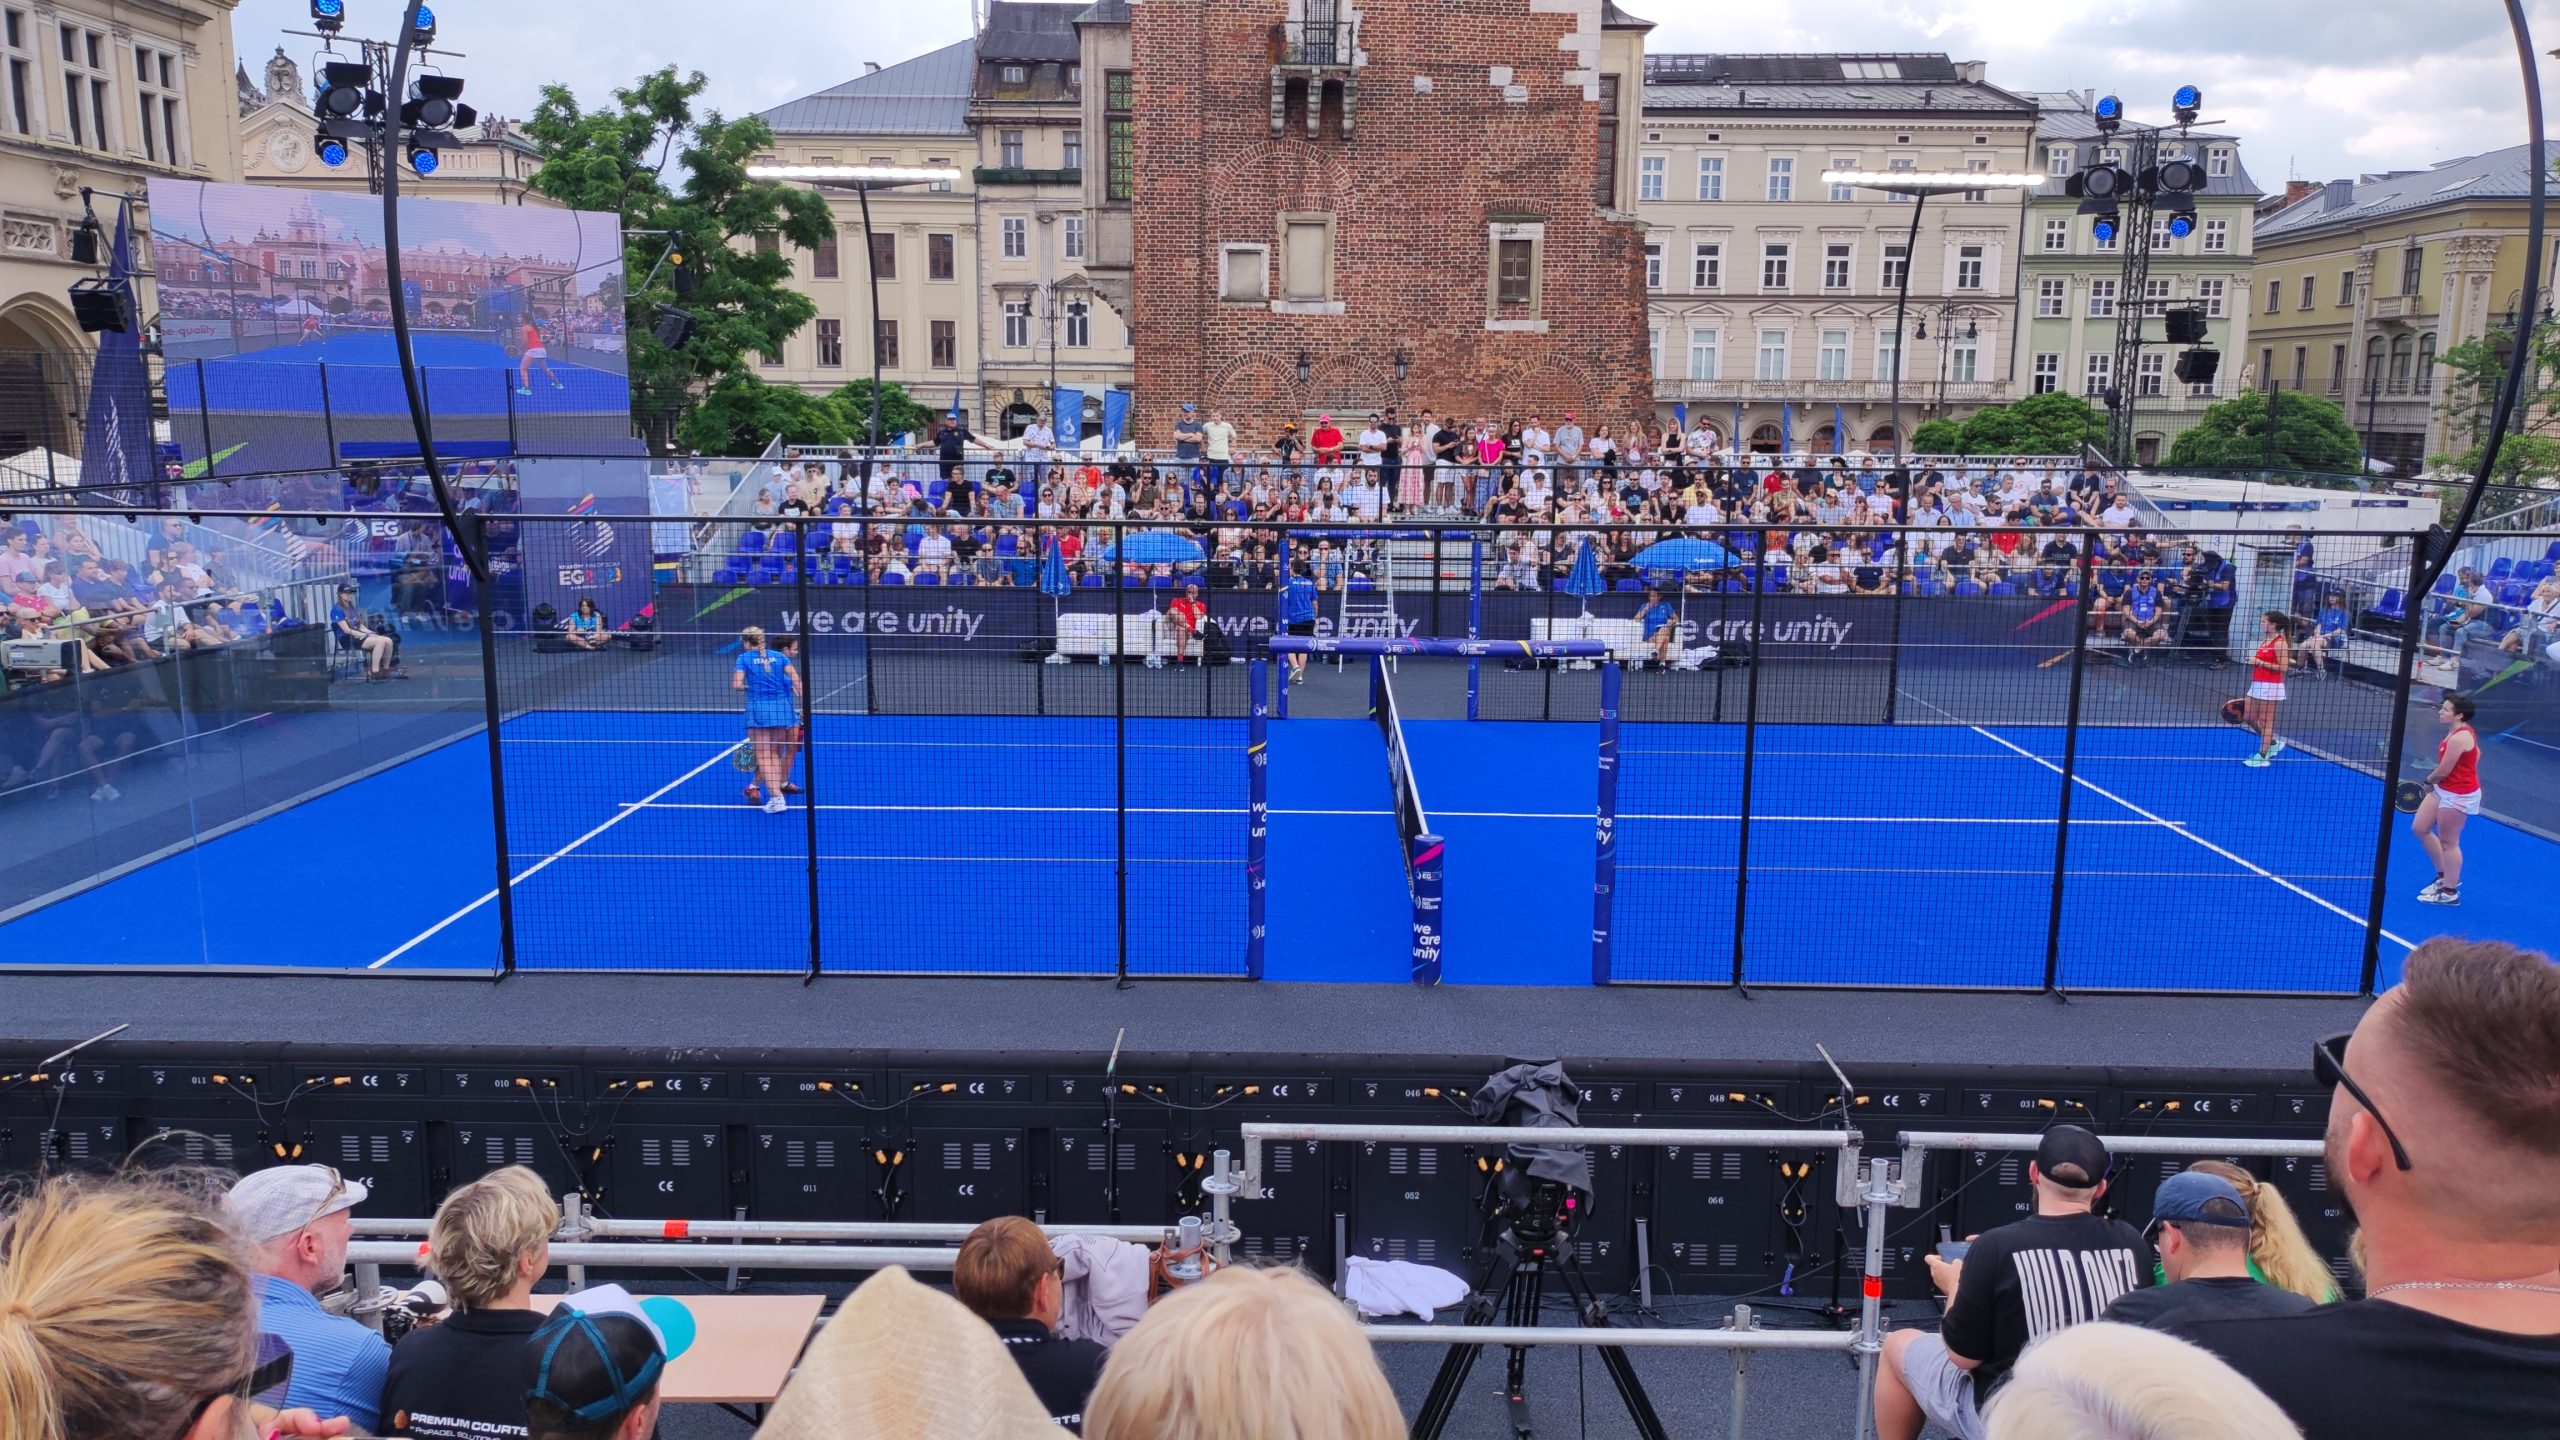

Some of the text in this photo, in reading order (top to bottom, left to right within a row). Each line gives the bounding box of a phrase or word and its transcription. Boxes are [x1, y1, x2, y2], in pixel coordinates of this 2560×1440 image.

[781, 605, 985, 641] we are unity
[1217, 615, 1269, 638] we
[1682, 613, 1853, 650] e are unity
[1413, 922, 1432, 935] we
[1419, 934, 1441, 946] are
[1412, 946, 1440, 962] unity
[495, 1079, 510, 1089] 010
[800, 1082, 816, 1092] 009
[1405, 1088, 1421, 1098] 046
[1709, 1093, 1725, 1103] 048
[2020, 1099, 2036, 1109] 031
[1708, 1195, 1724, 1206] 066
[2015, 1202, 2030, 1212] 061
[410, 1412, 530, 1436] PREMIUM COURTS
